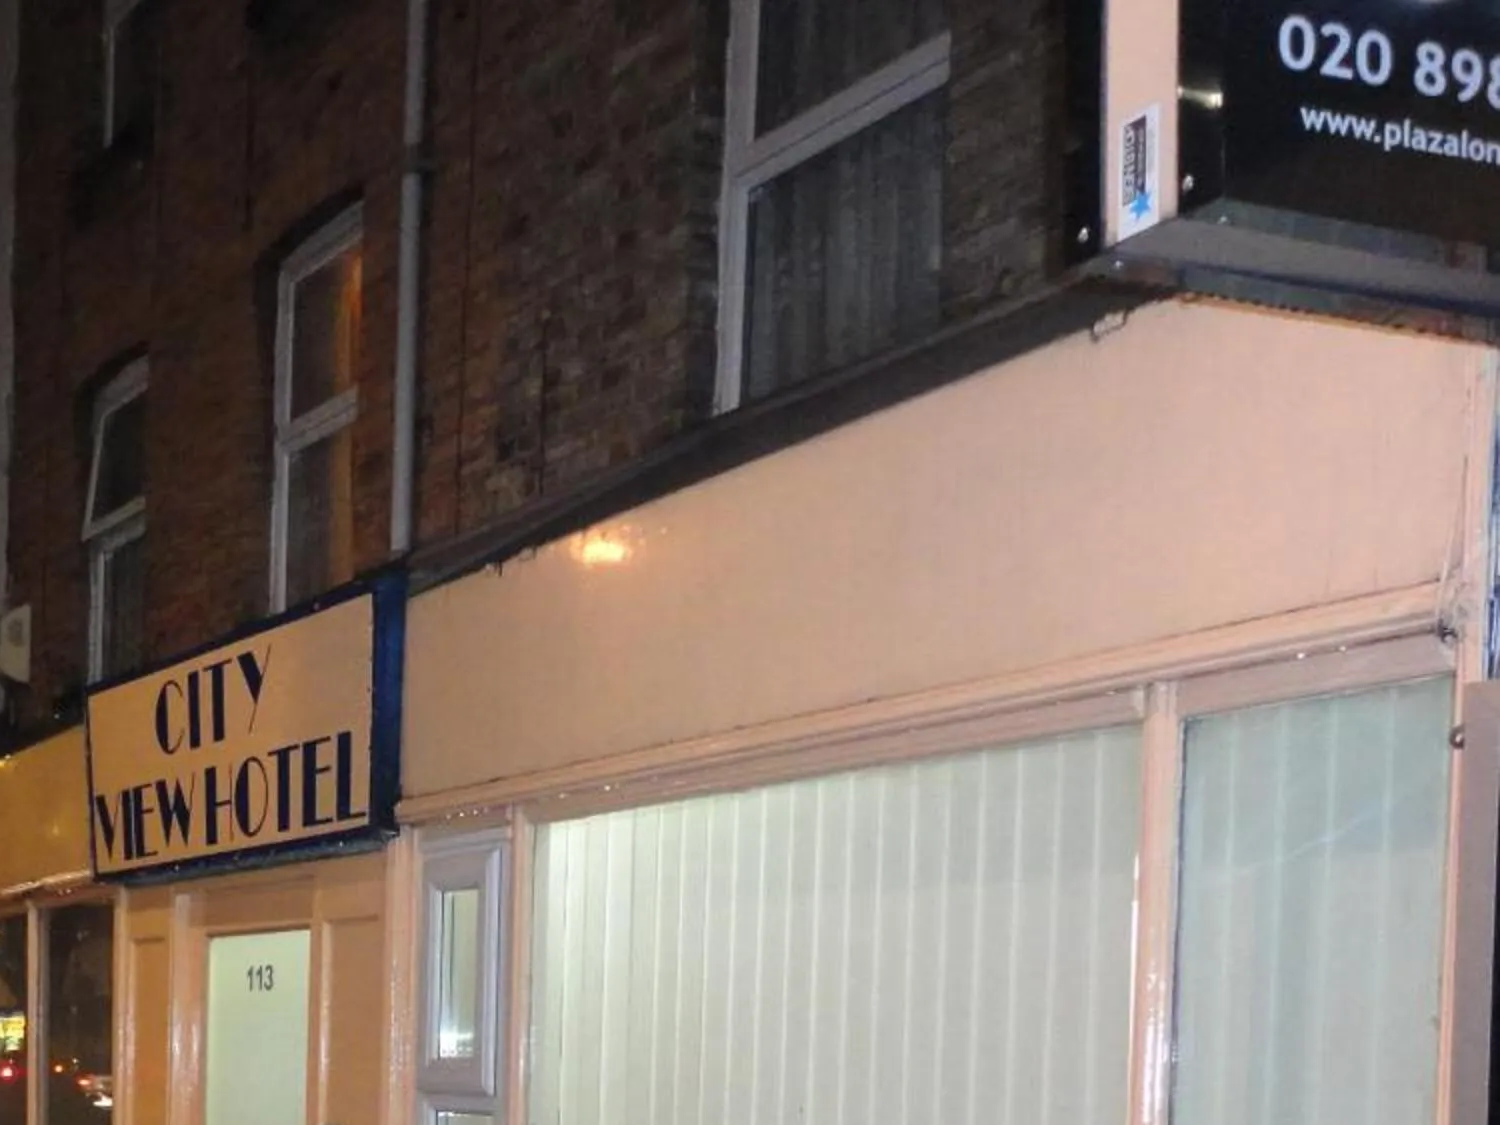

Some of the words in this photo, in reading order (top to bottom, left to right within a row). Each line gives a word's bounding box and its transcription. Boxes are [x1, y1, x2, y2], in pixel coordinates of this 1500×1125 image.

[1278, 14, 1393, 87] 020
[155, 644, 272, 755] CITY
[96, 772, 196, 864] VIEW
[204, 731, 367, 845] HOTEL
[246, 964, 274, 992] 113
